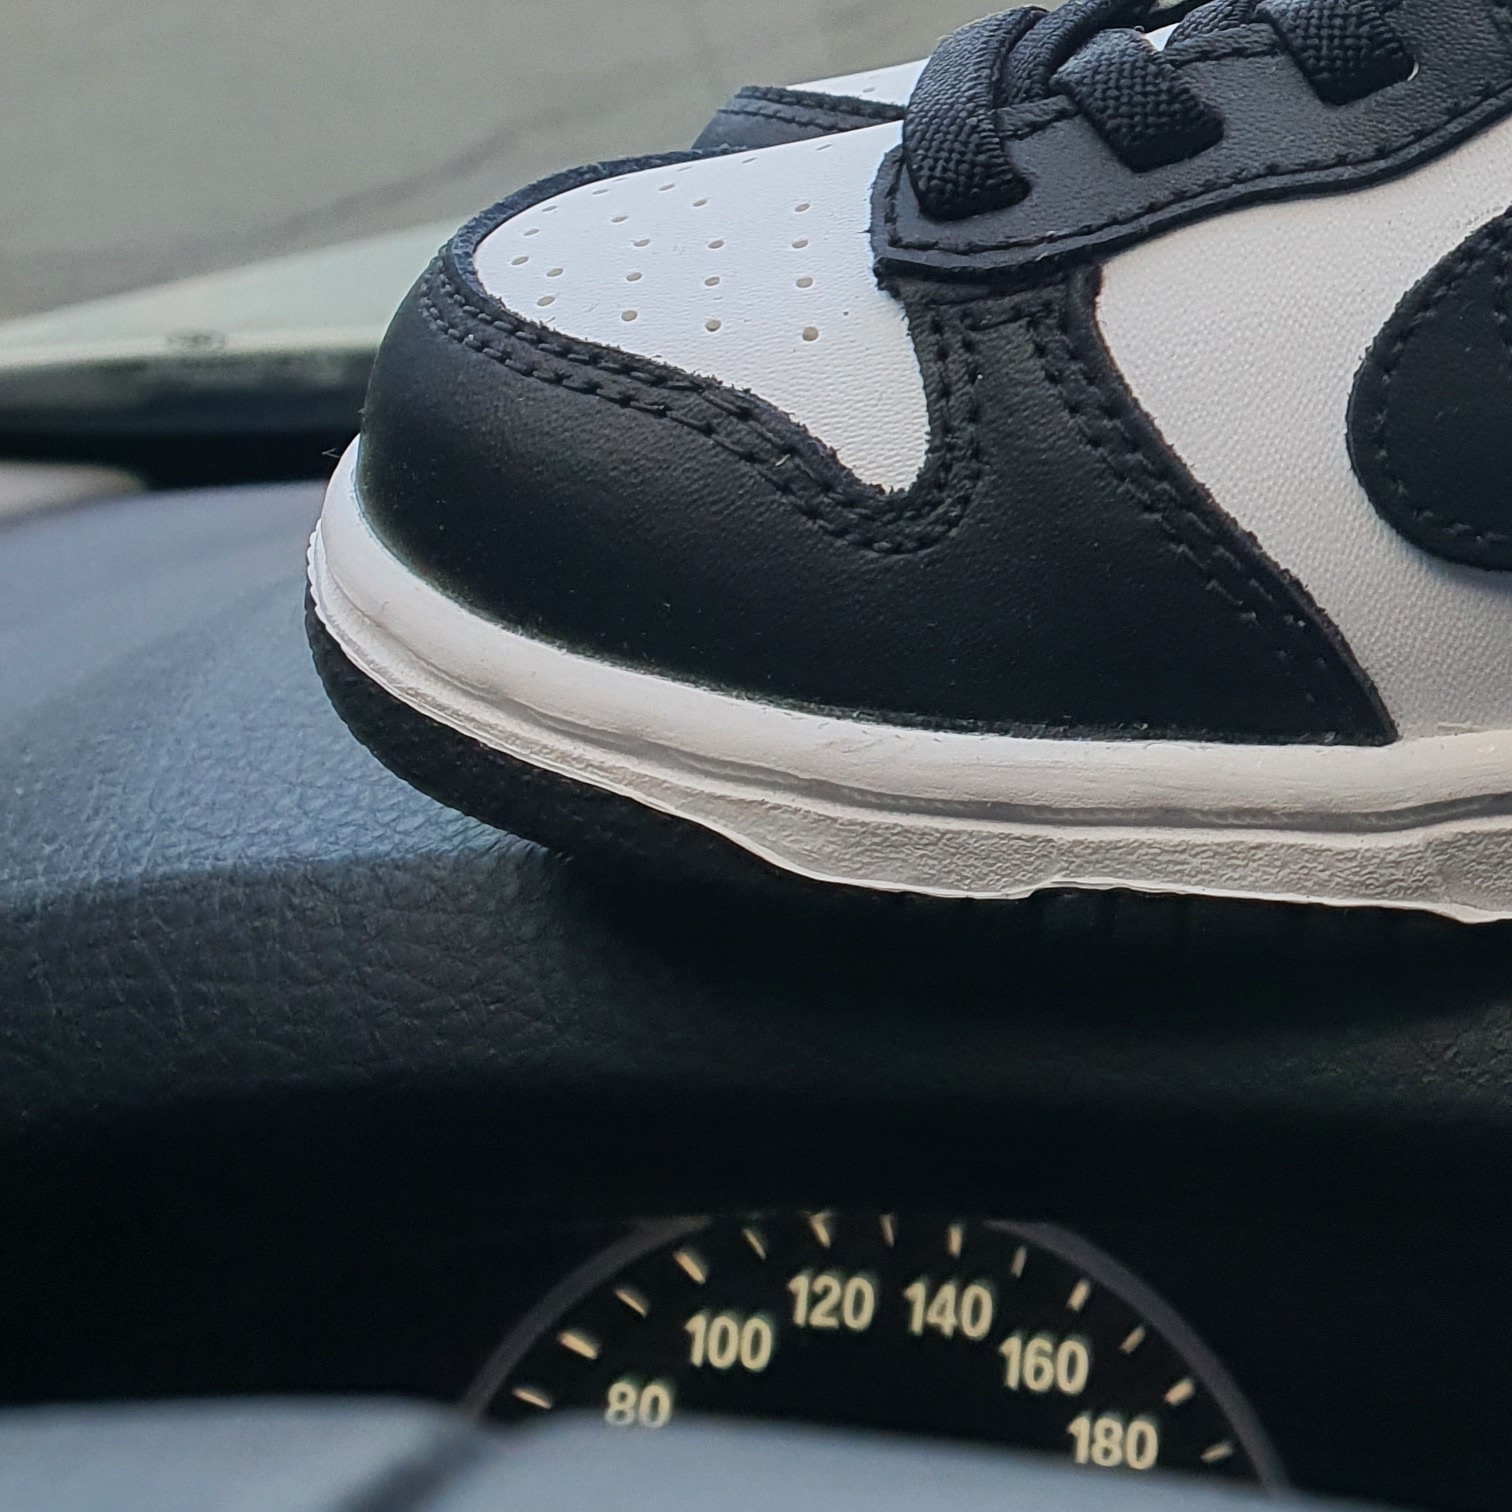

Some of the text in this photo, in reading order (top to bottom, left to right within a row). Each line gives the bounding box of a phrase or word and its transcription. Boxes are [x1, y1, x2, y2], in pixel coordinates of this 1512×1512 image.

[788, 1272, 876, 1330] 120
[903, 1280, 994, 1339] 140
[684, 1313, 774, 1371] 100
[1000, 1334, 1090, 1395] 160
[605, 1380, 672, 1428] 80
[1066, 1415, 1160, 1471] 180
